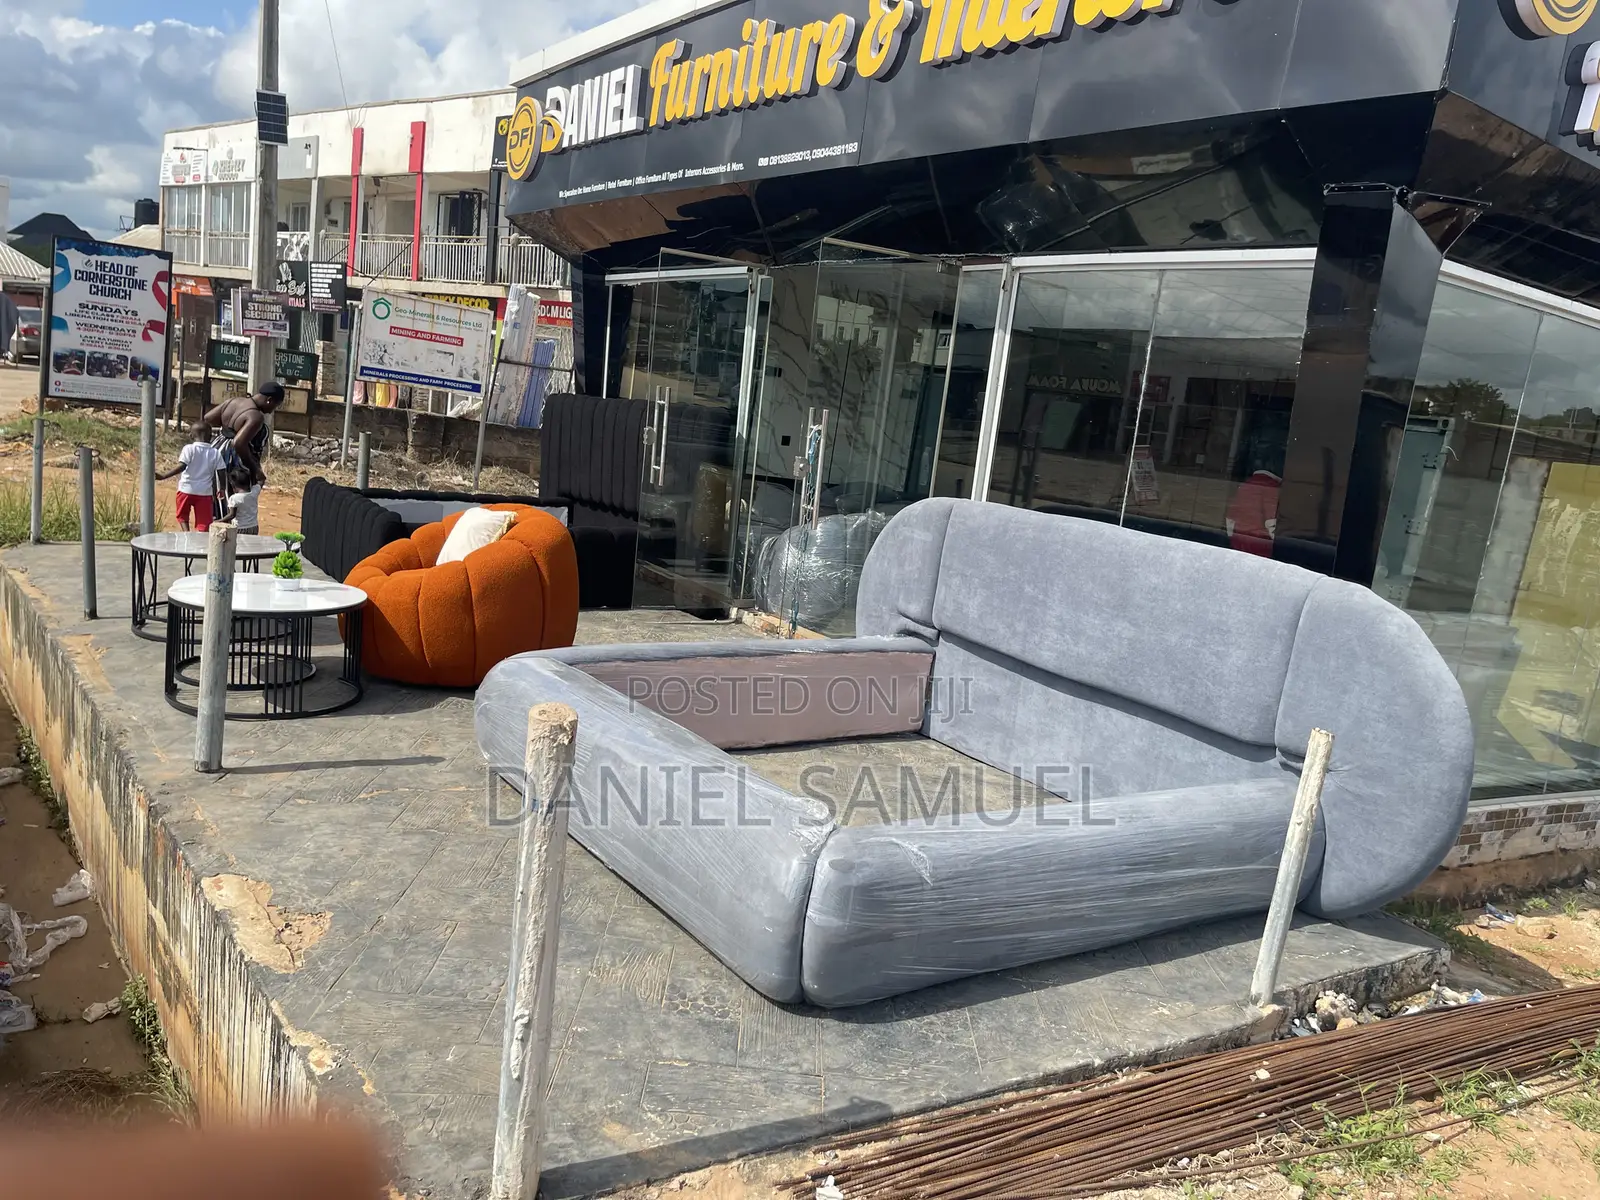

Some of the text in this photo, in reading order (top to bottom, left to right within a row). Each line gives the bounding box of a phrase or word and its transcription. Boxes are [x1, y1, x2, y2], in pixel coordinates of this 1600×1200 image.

[541, 64, 641, 153] DANIEL
[649, 13, 851, 127] Furniture
[856, 0, 911, 78] &
[509, 126, 534, 150] DFI
[617, 178, 632, 188] Furniture
[667, 171, 677, 182] Types
[685, 168, 702, 178] Interiors
[702, 164, 726, 177] Accessories
[726, 163, 731, 172] &
[731, 162, 745, 172] More.
[95, 260, 138, 277] HEAD OF
[74, 269, 148, 291] CORNERSTONE
[89, 284, 132, 301] CHURCH
[78, 302, 139, 317] SUNDAYS
[248, 302, 283, 313] STRONG
[457, 297, 489, 310] DECOR
[65, 312, 109, 323] LIBERATION
[91, 311, 115, 319] CLASS
[245, 310, 286, 321] SECURITY
[441, 315, 472, 327] Resources
[75, 321, 137, 334] WEDNESDAYS
[391, 328, 463, 345] MINING AND FARMING
[221, 345, 239, 356] HEAD
[363, 369, 389, 378] MINERALS
[388, 372, 419, 382] PROCESSING
[444, 381, 473, 390] PROCESSING
